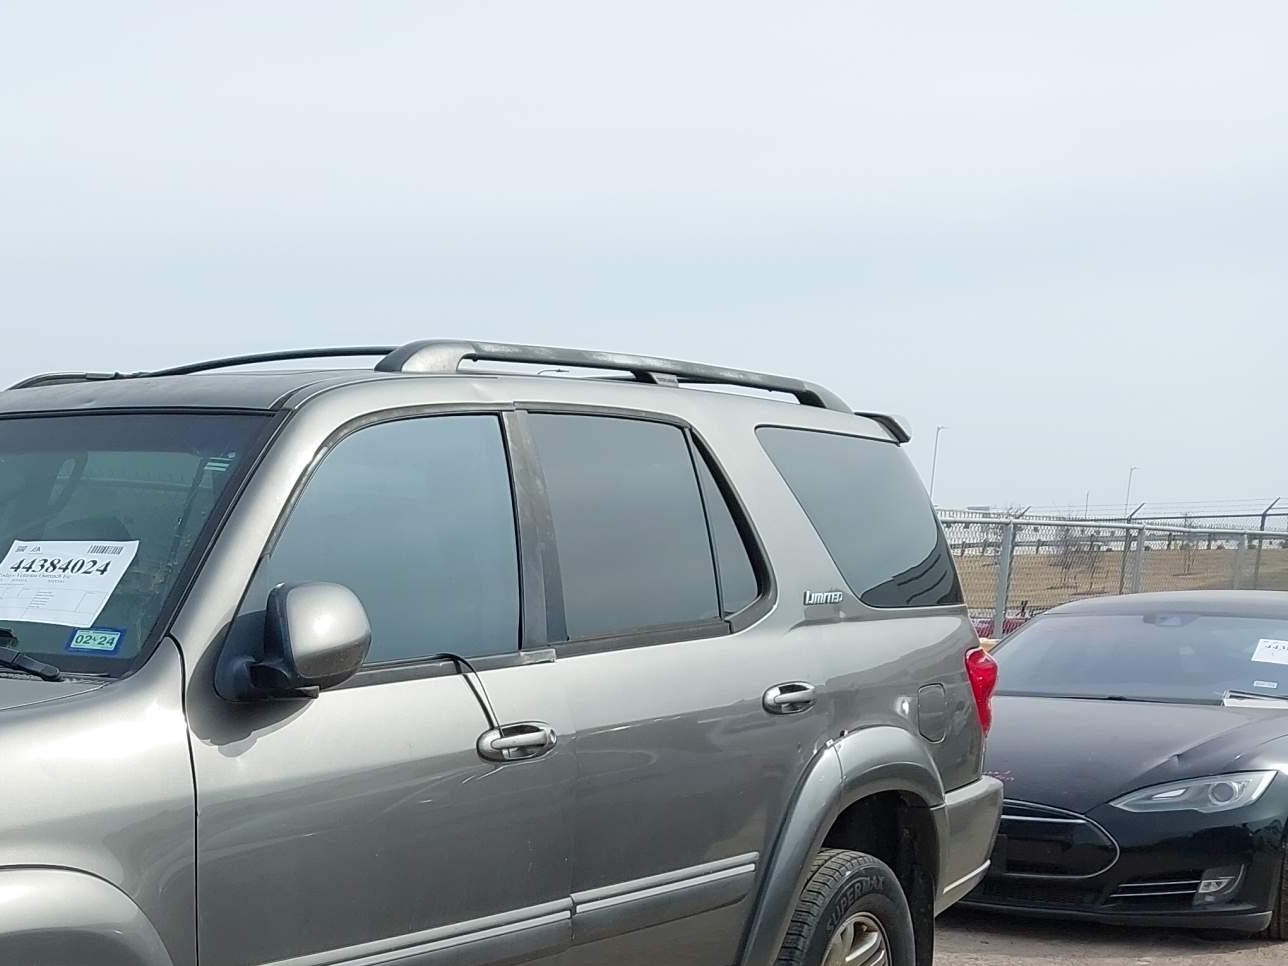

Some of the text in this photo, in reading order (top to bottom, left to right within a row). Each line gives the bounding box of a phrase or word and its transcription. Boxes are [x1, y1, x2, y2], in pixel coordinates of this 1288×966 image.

[10, 558, 111, 575] 44384024
[74, 634, 116, 647] 02 24
